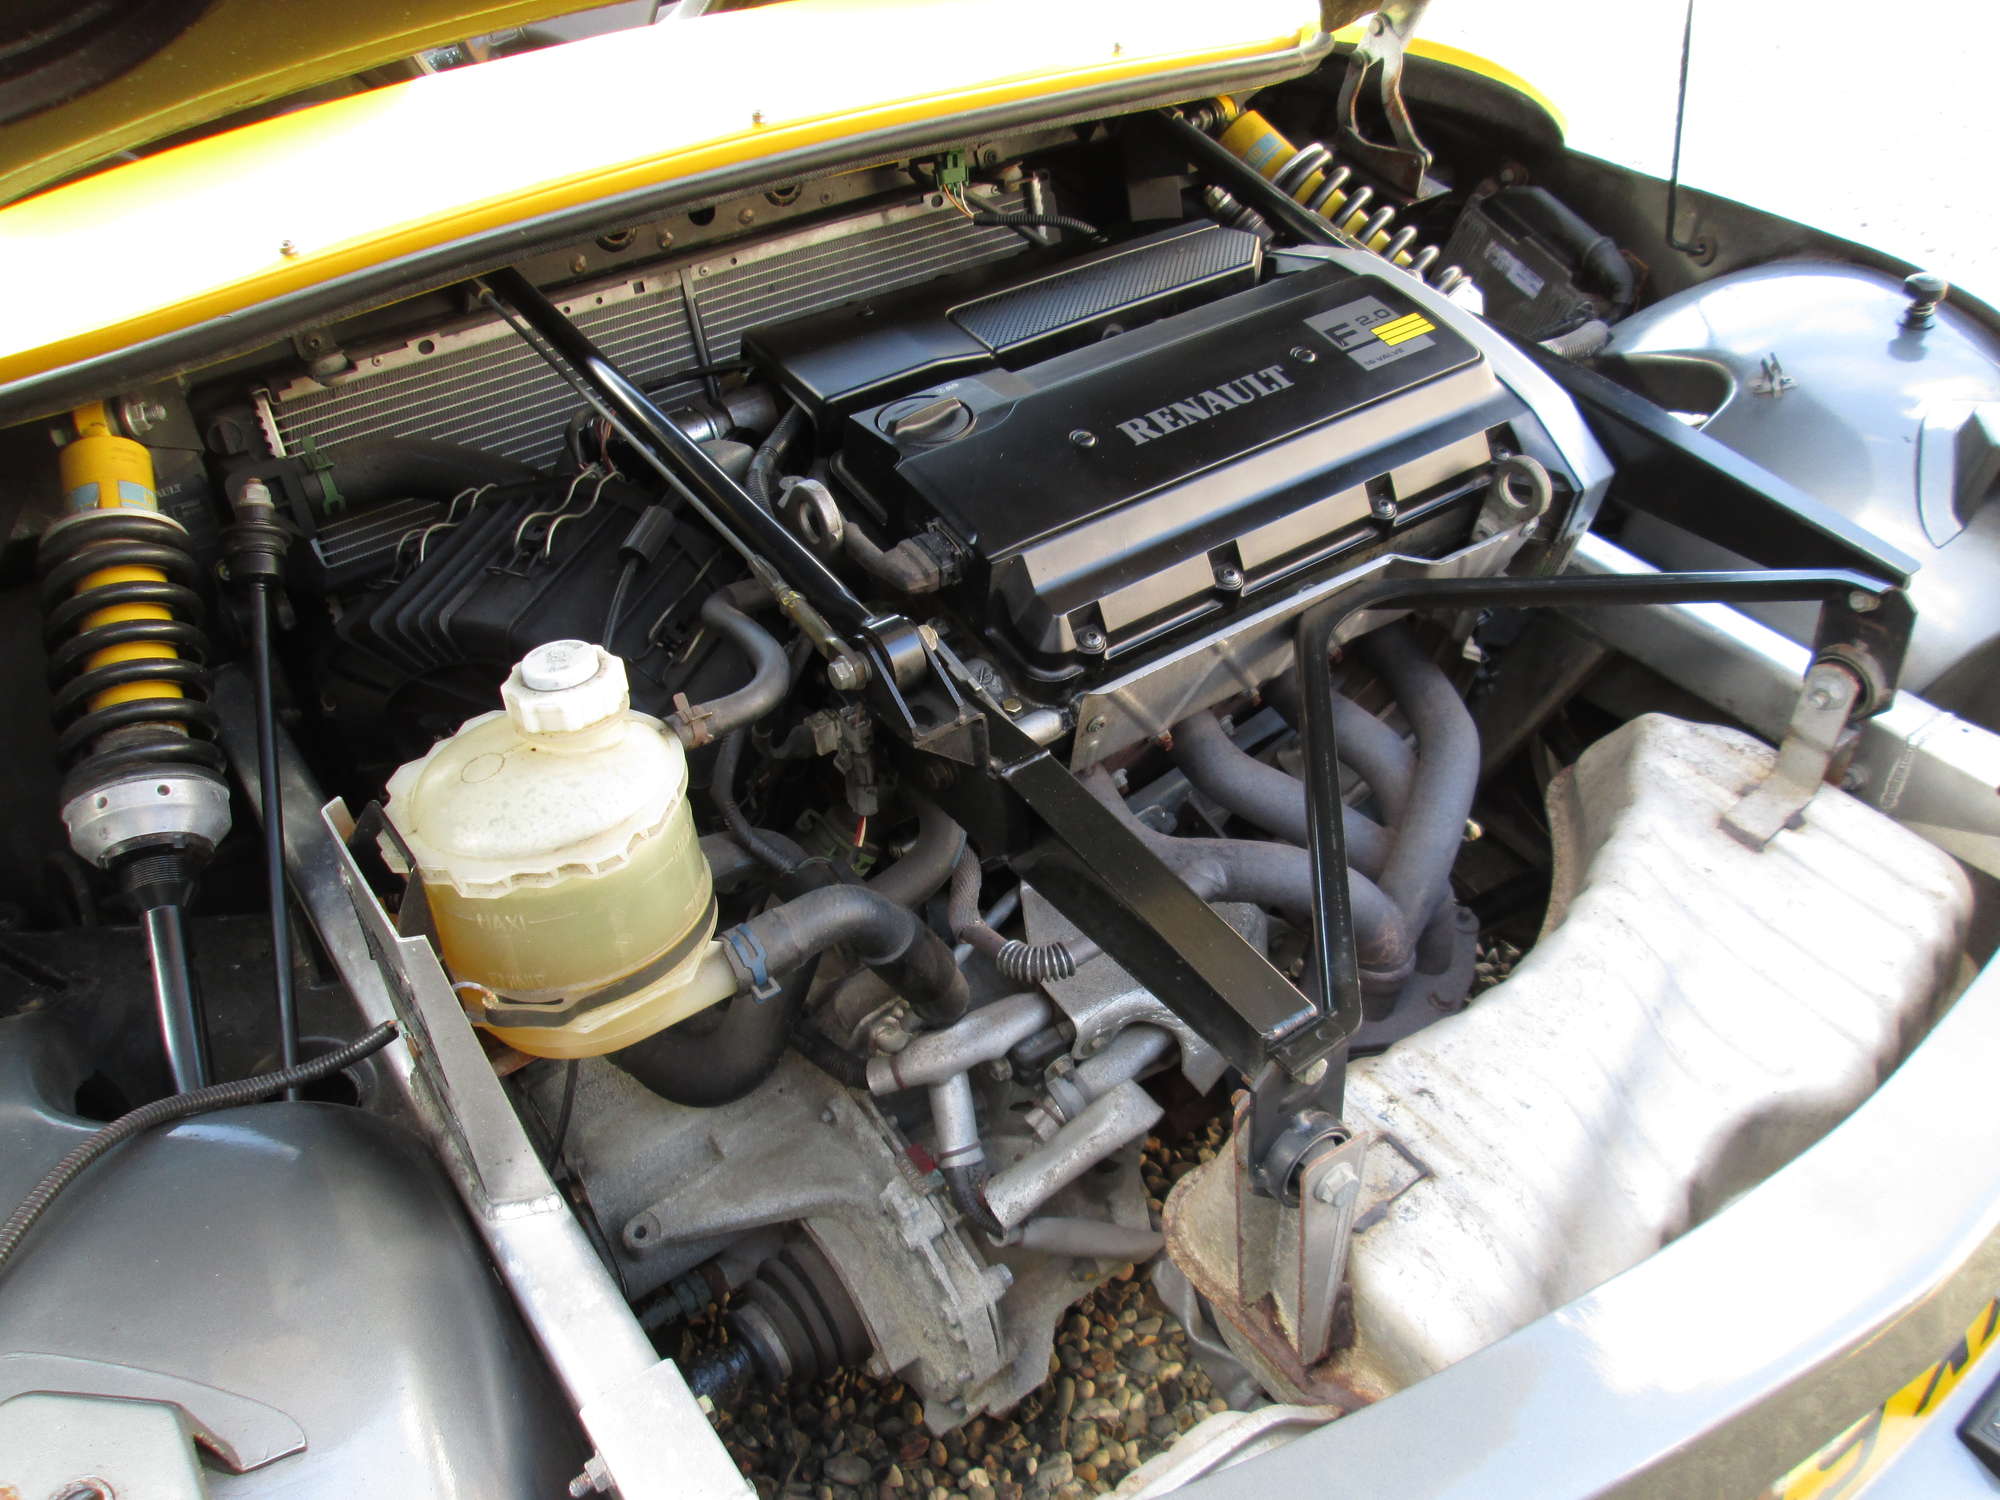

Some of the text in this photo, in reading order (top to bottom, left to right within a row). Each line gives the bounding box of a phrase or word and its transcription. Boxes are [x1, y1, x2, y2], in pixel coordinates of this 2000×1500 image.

[1354, 309, 1391, 326] 2.0
[1115, 364, 1296, 446] RENAULT
[476, 912, 527, 932] MAXI
